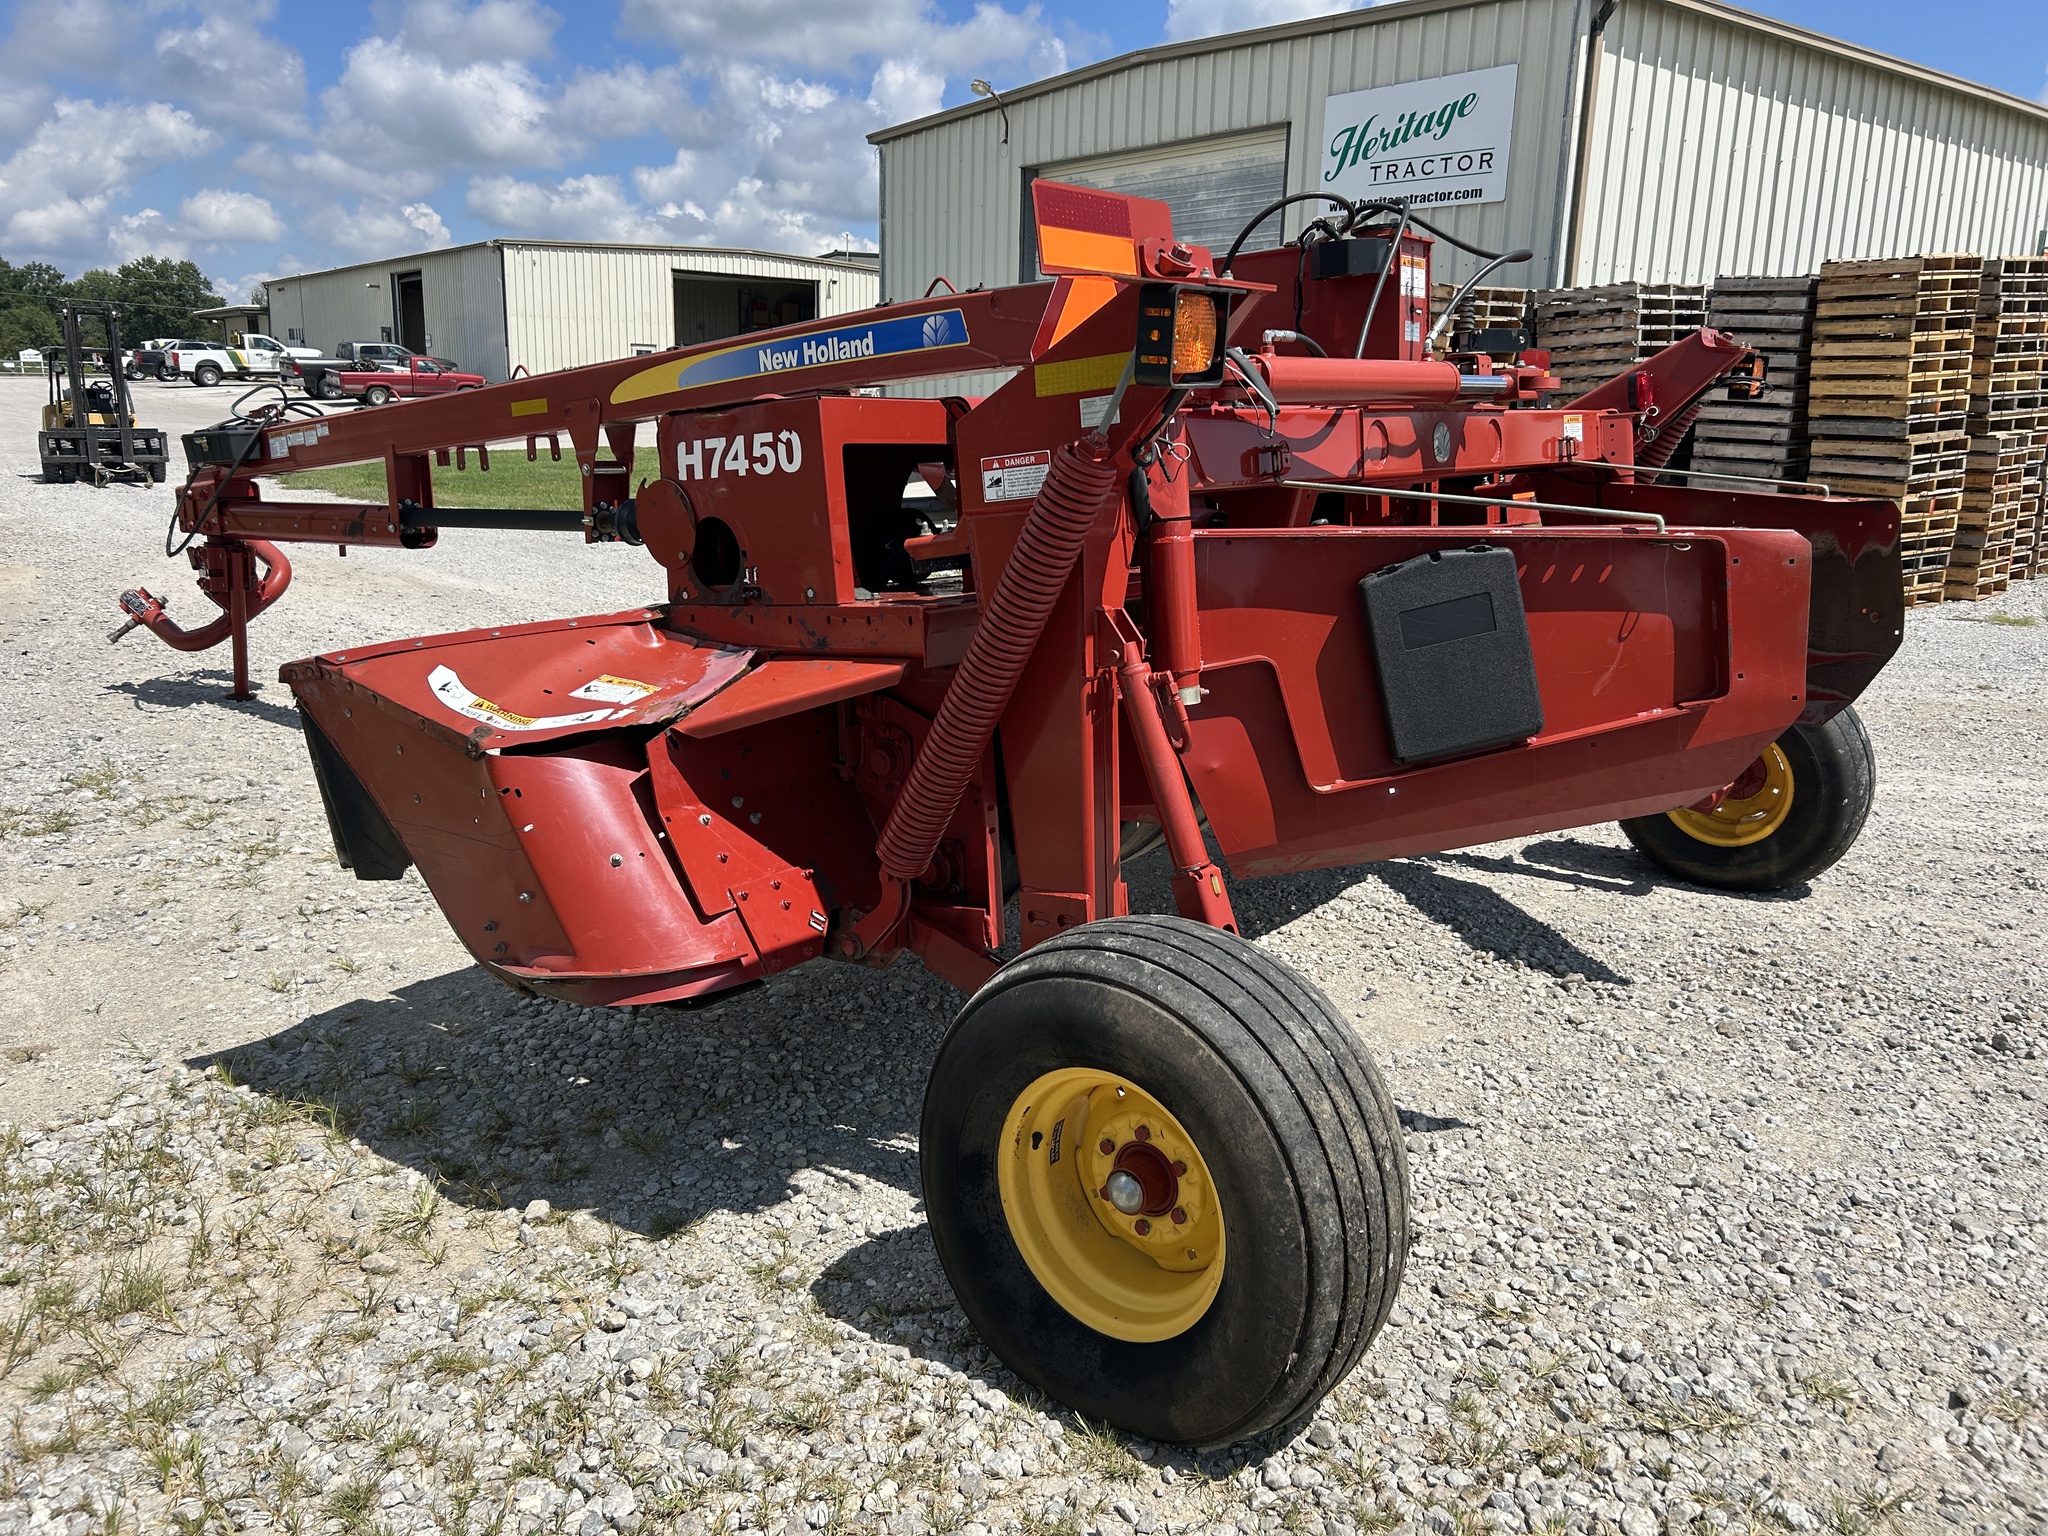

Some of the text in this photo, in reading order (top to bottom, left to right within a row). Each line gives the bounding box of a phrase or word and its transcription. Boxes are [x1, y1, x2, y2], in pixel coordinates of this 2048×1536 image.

[1324, 92, 1479, 182] Heritage
[1370, 152, 1493, 182] TRACTOR
[1329, 187, 1483, 212] wwwhrittractor.com
[758, 330, 874, 372] New Holland
[677, 428, 802, 481] H7450
[1004, 456, 1035, 467] DANGER
[485, 703, 531, 724] WARNING
